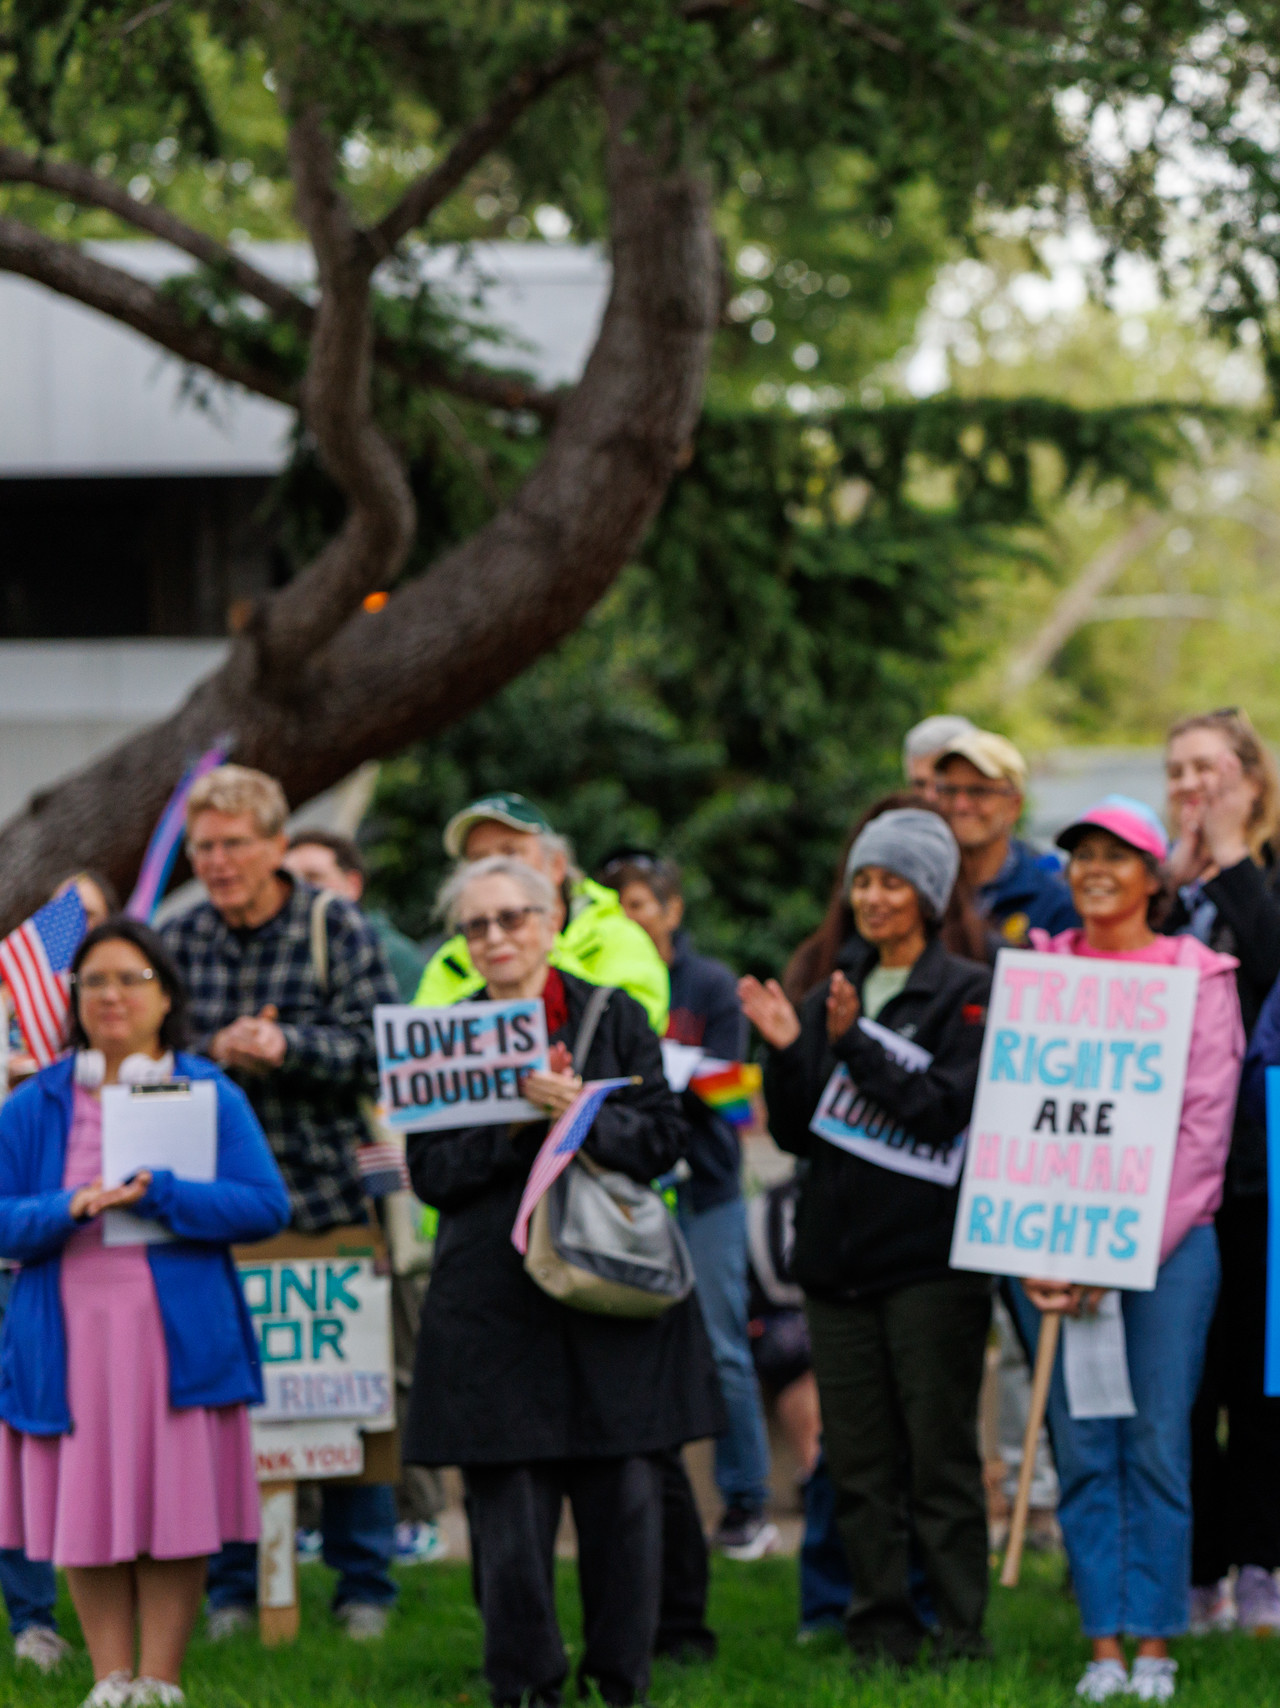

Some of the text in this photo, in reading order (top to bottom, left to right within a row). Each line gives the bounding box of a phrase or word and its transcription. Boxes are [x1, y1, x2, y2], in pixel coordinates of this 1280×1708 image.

[1004, 968, 1168, 1032] TRANS
[385, 1013, 535, 1060] LOVE IS
[989, 1030, 1163, 1093] RIGHTS
[1033, 1096, 1115, 1136] ARE
[973, 1133, 1156, 1195] HUMAN
[967, 1195, 1140, 1260] RIGHTS
[239, 1264, 361, 1315] ONK
[259, 1318, 344, 1363] OR
[278, 1370, 390, 1415] RIGHTS
